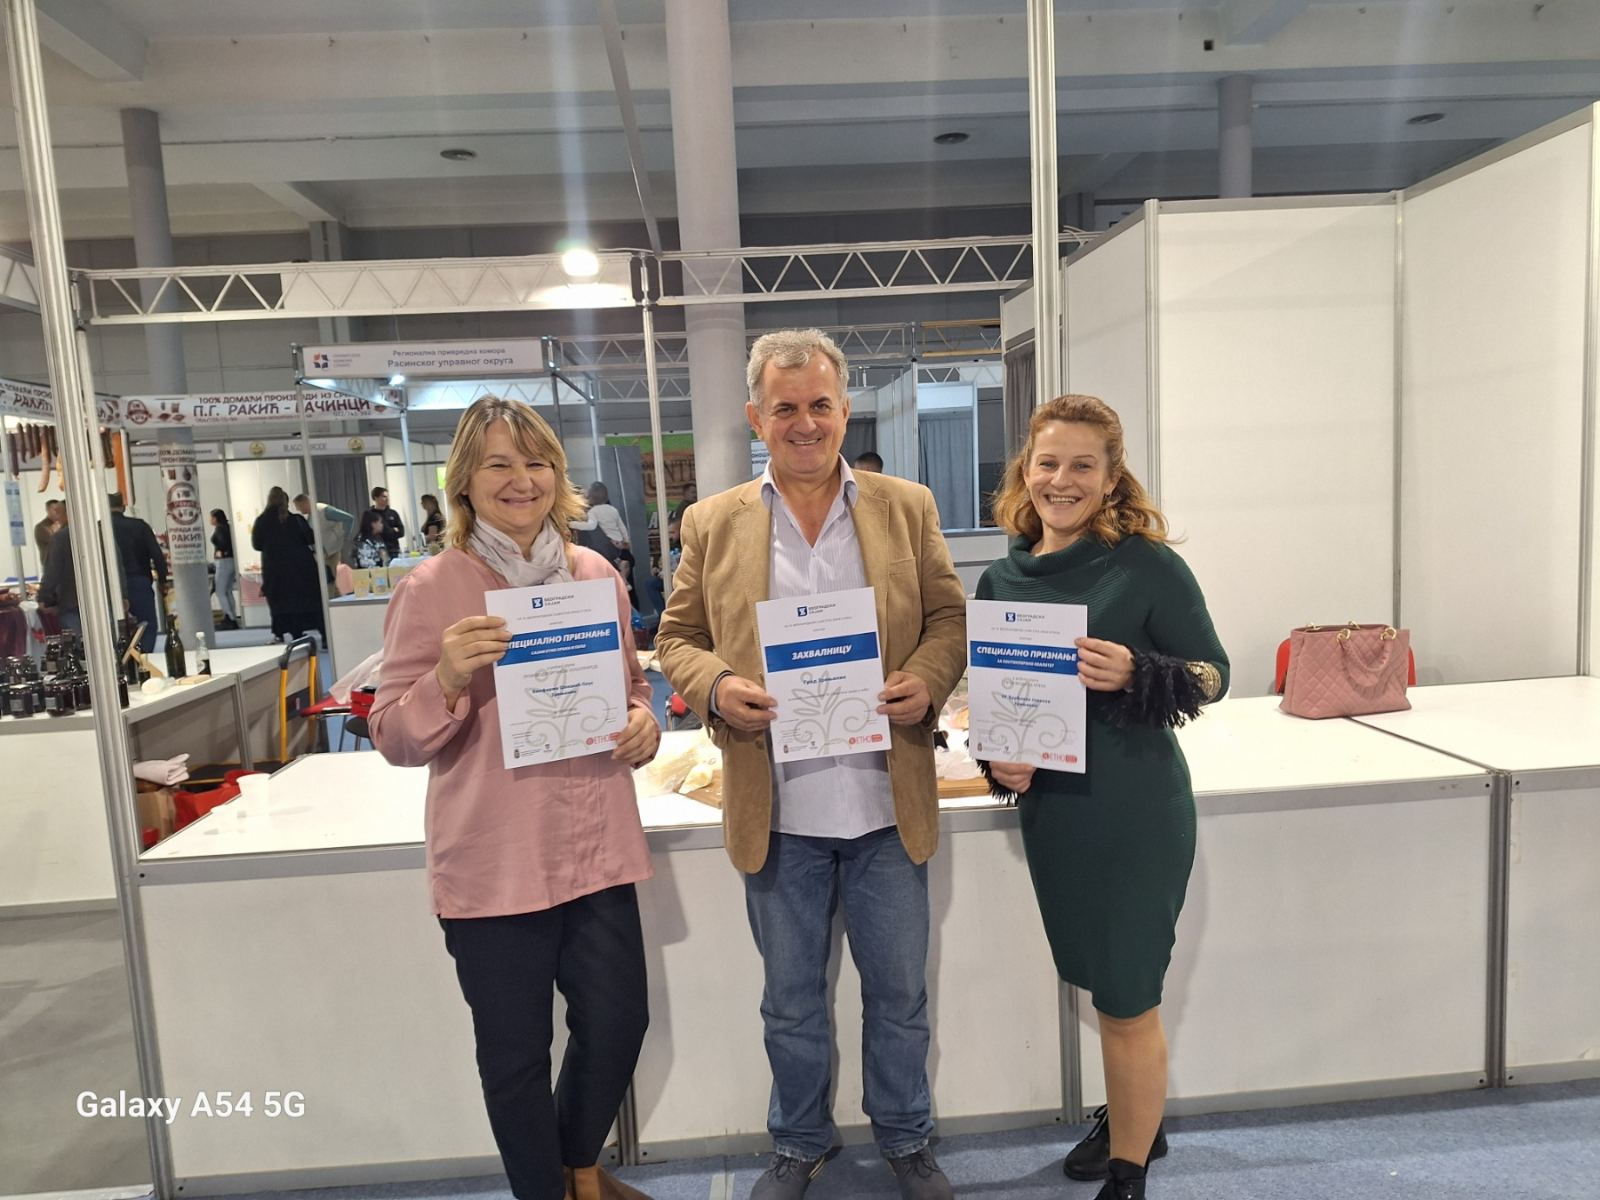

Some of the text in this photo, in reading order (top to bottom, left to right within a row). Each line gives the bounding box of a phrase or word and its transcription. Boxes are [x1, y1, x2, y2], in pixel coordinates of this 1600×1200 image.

[438, 348, 477, 356] привредна
[387, 357, 514, 368] Расинског управног округа
[223, 396, 262, 404] ДОМАЋИ
[193, 405, 220, 417] П.Г.
[228, 403, 279, 416] РАКИЋ
[508, 628, 611, 649] ПЕЦИЈАЛНО ПРИЗНАЊЕ
[792, 644, 852, 660] ЗАХВАЛНИЦУ
[976, 646, 1077, 661] СПЕЦИЈАЛНО ПРИЗНАЊЕ
